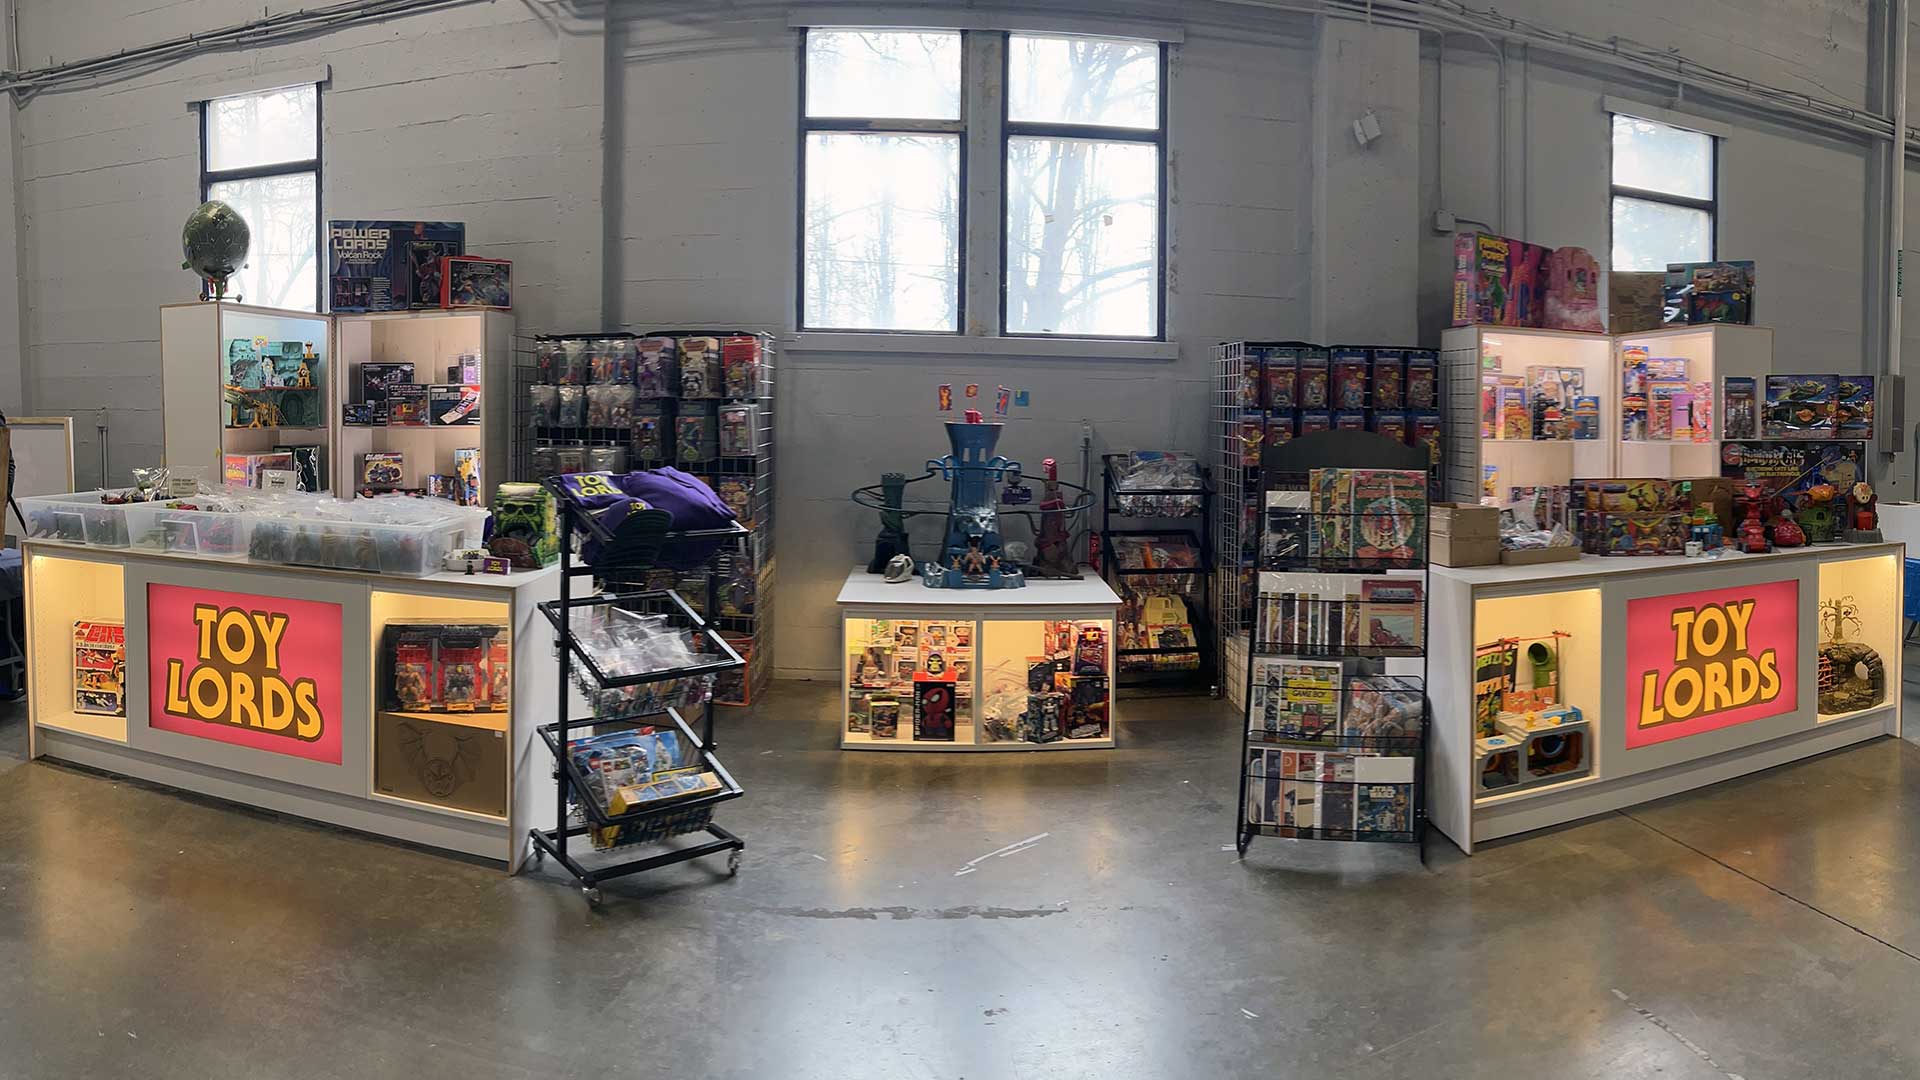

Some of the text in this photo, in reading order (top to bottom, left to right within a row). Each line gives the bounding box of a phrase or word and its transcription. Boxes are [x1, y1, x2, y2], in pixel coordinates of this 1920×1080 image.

[331, 228, 390, 239] POWER
[334, 239, 388, 250] LORDS
[195, 606, 288, 670] TOY
[1672, 602, 1755, 661] TOY
[166, 660, 322, 738] LORDS
[1638, 651, 1780, 726] LORDS
